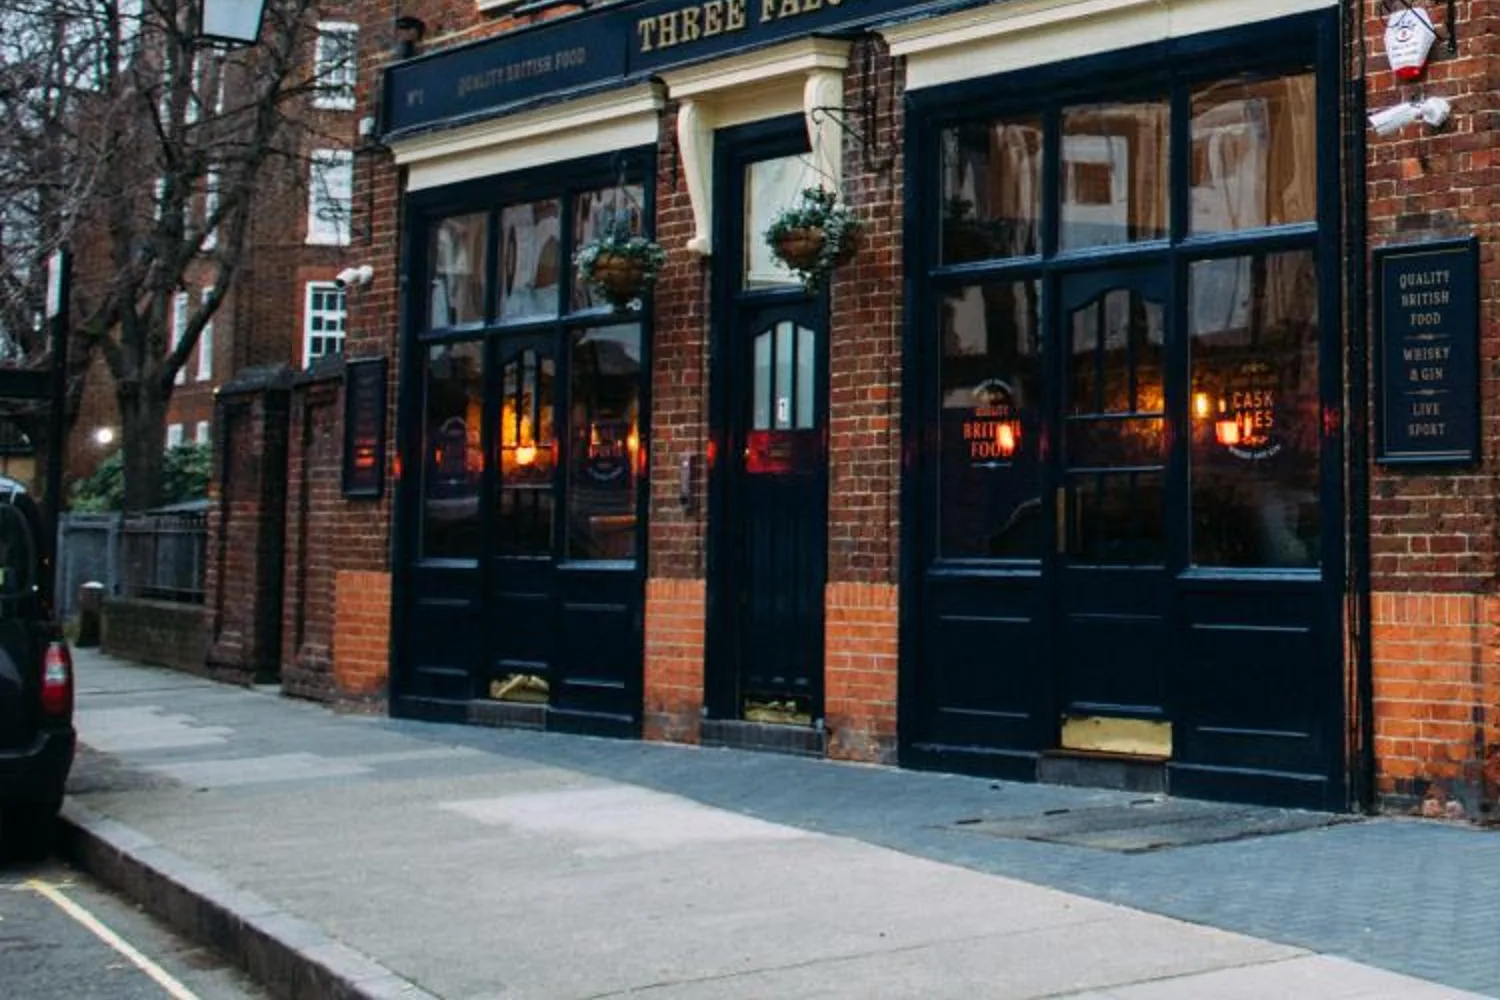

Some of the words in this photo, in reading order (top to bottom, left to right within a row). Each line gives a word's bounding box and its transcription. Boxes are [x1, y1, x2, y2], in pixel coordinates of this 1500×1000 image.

[1399, 269, 1450, 289] QUALITY
[1401, 291, 1450, 307] BRITISH
[1409, 312, 1441, 326] FOOD
[1403, 347, 1450, 362] WHISKY
[1421, 367, 1444, 381] GIN
[1232, 390, 1274, 408] CASK
[1412, 402, 1440, 416] LIVE
[963, 419, 1022, 441] BRITH
[1407, 422, 1446, 437] SPORT
